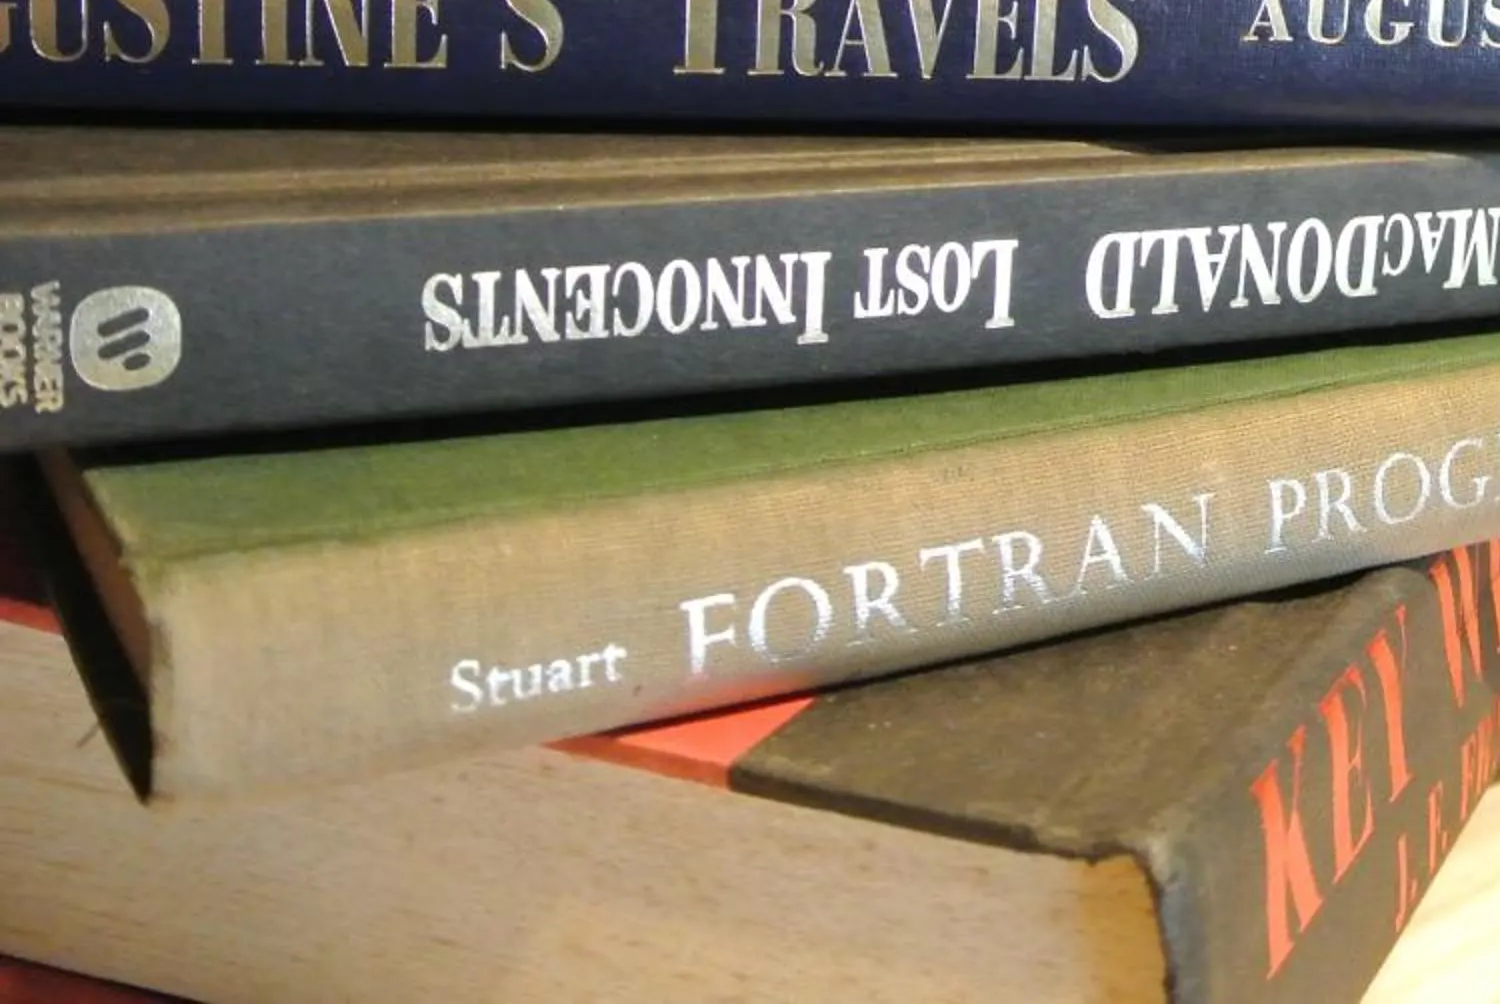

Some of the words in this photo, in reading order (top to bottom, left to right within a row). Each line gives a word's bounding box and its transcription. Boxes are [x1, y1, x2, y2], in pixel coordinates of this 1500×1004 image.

[421, 250, 832, 352] INNOCENTS
[852, 238, 1019, 329] LOST
[0, 292, 29, 408] BOOKS
[31, 279, 65, 415] WARNER
[450, 641, 627, 713] Stuart
[678, 492, 1216, 679] FORTRAN
[1249, 602, 1414, 981] KEY
